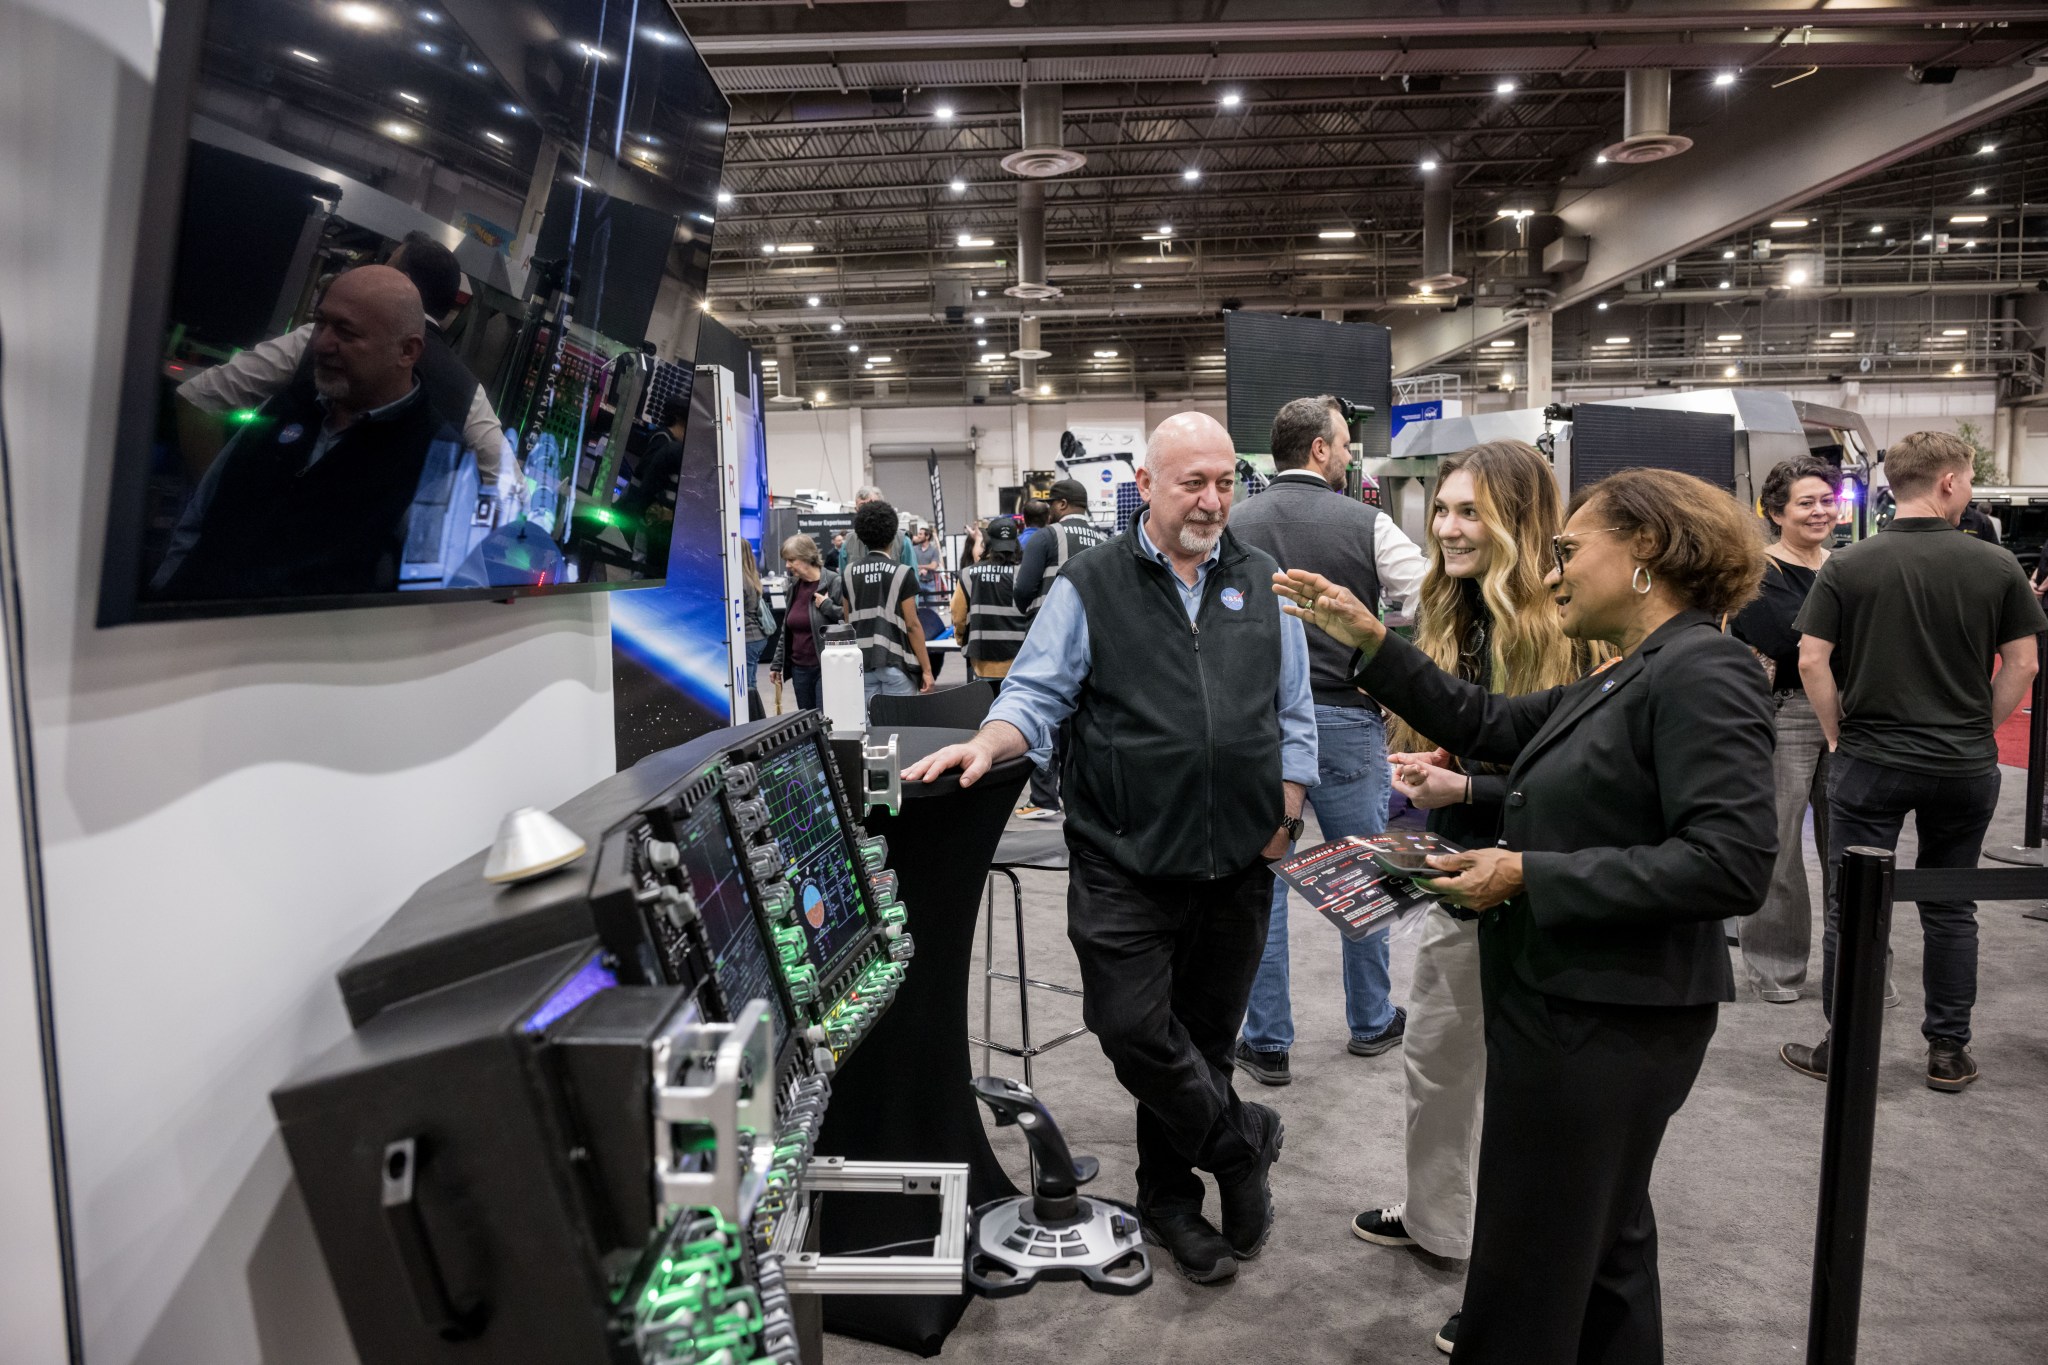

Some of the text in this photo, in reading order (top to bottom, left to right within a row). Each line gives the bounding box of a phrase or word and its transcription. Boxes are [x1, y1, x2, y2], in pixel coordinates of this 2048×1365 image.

[1079, 535, 1096, 547] CREW
[853, 561, 897, 575] PRODUCTION
[969, 564, 1014, 575] PRODUCTION
[981, 573, 1001, 583] CREW
[1301, 848, 1334, 865] PHYSICS
